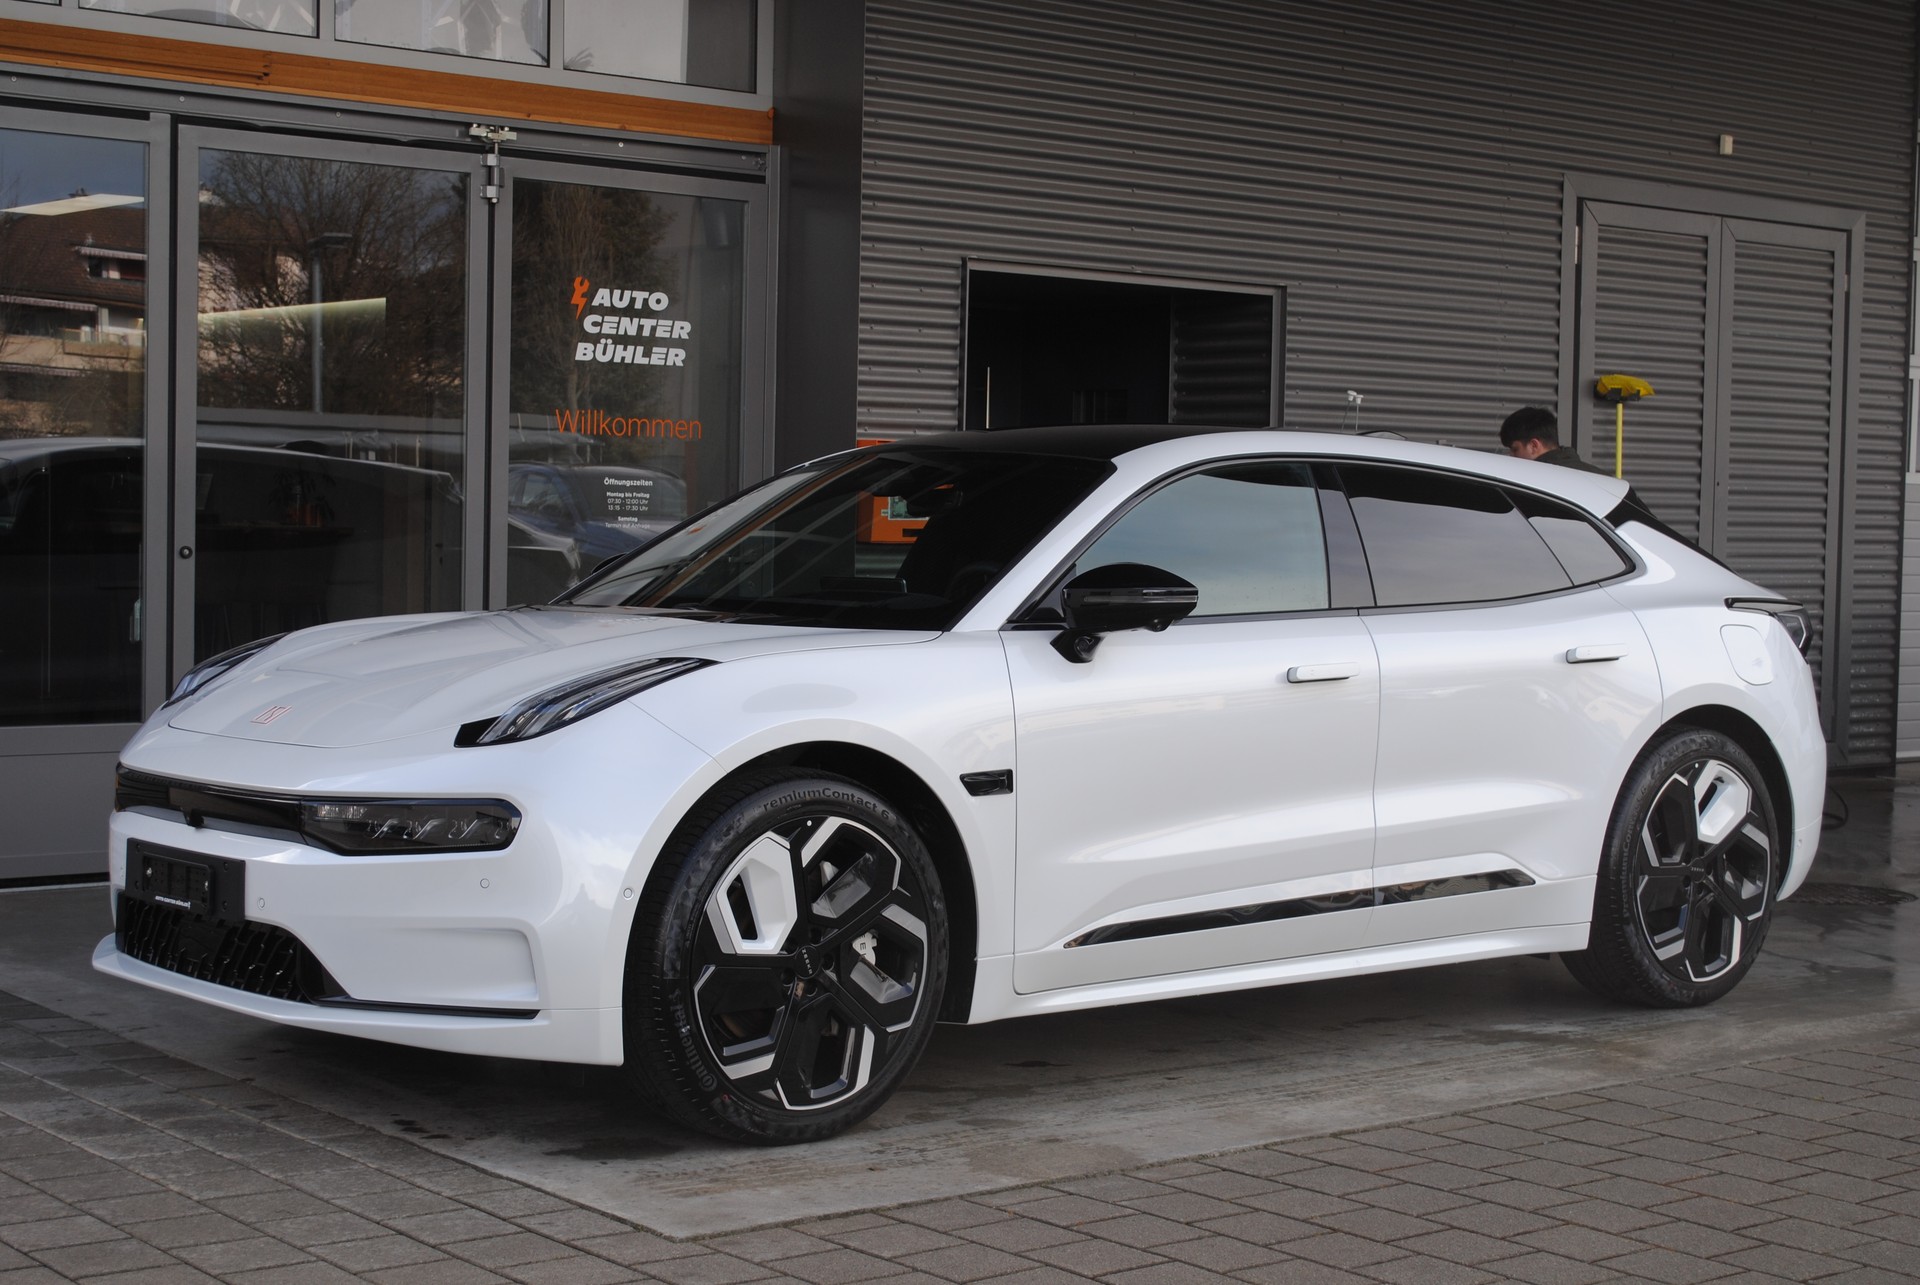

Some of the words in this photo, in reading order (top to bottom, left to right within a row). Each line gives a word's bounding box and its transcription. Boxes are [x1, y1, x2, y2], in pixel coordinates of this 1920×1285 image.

[591, 288, 669, 311] AUTO
[583, 314, 692, 339] CENTER
[574, 338, 686, 366] BÜHLER
[555, 408, 703, 440] Willkommen
[604, 476, 652, 486] Öffnungszeiten
[880, 809, 890, 820] 6
